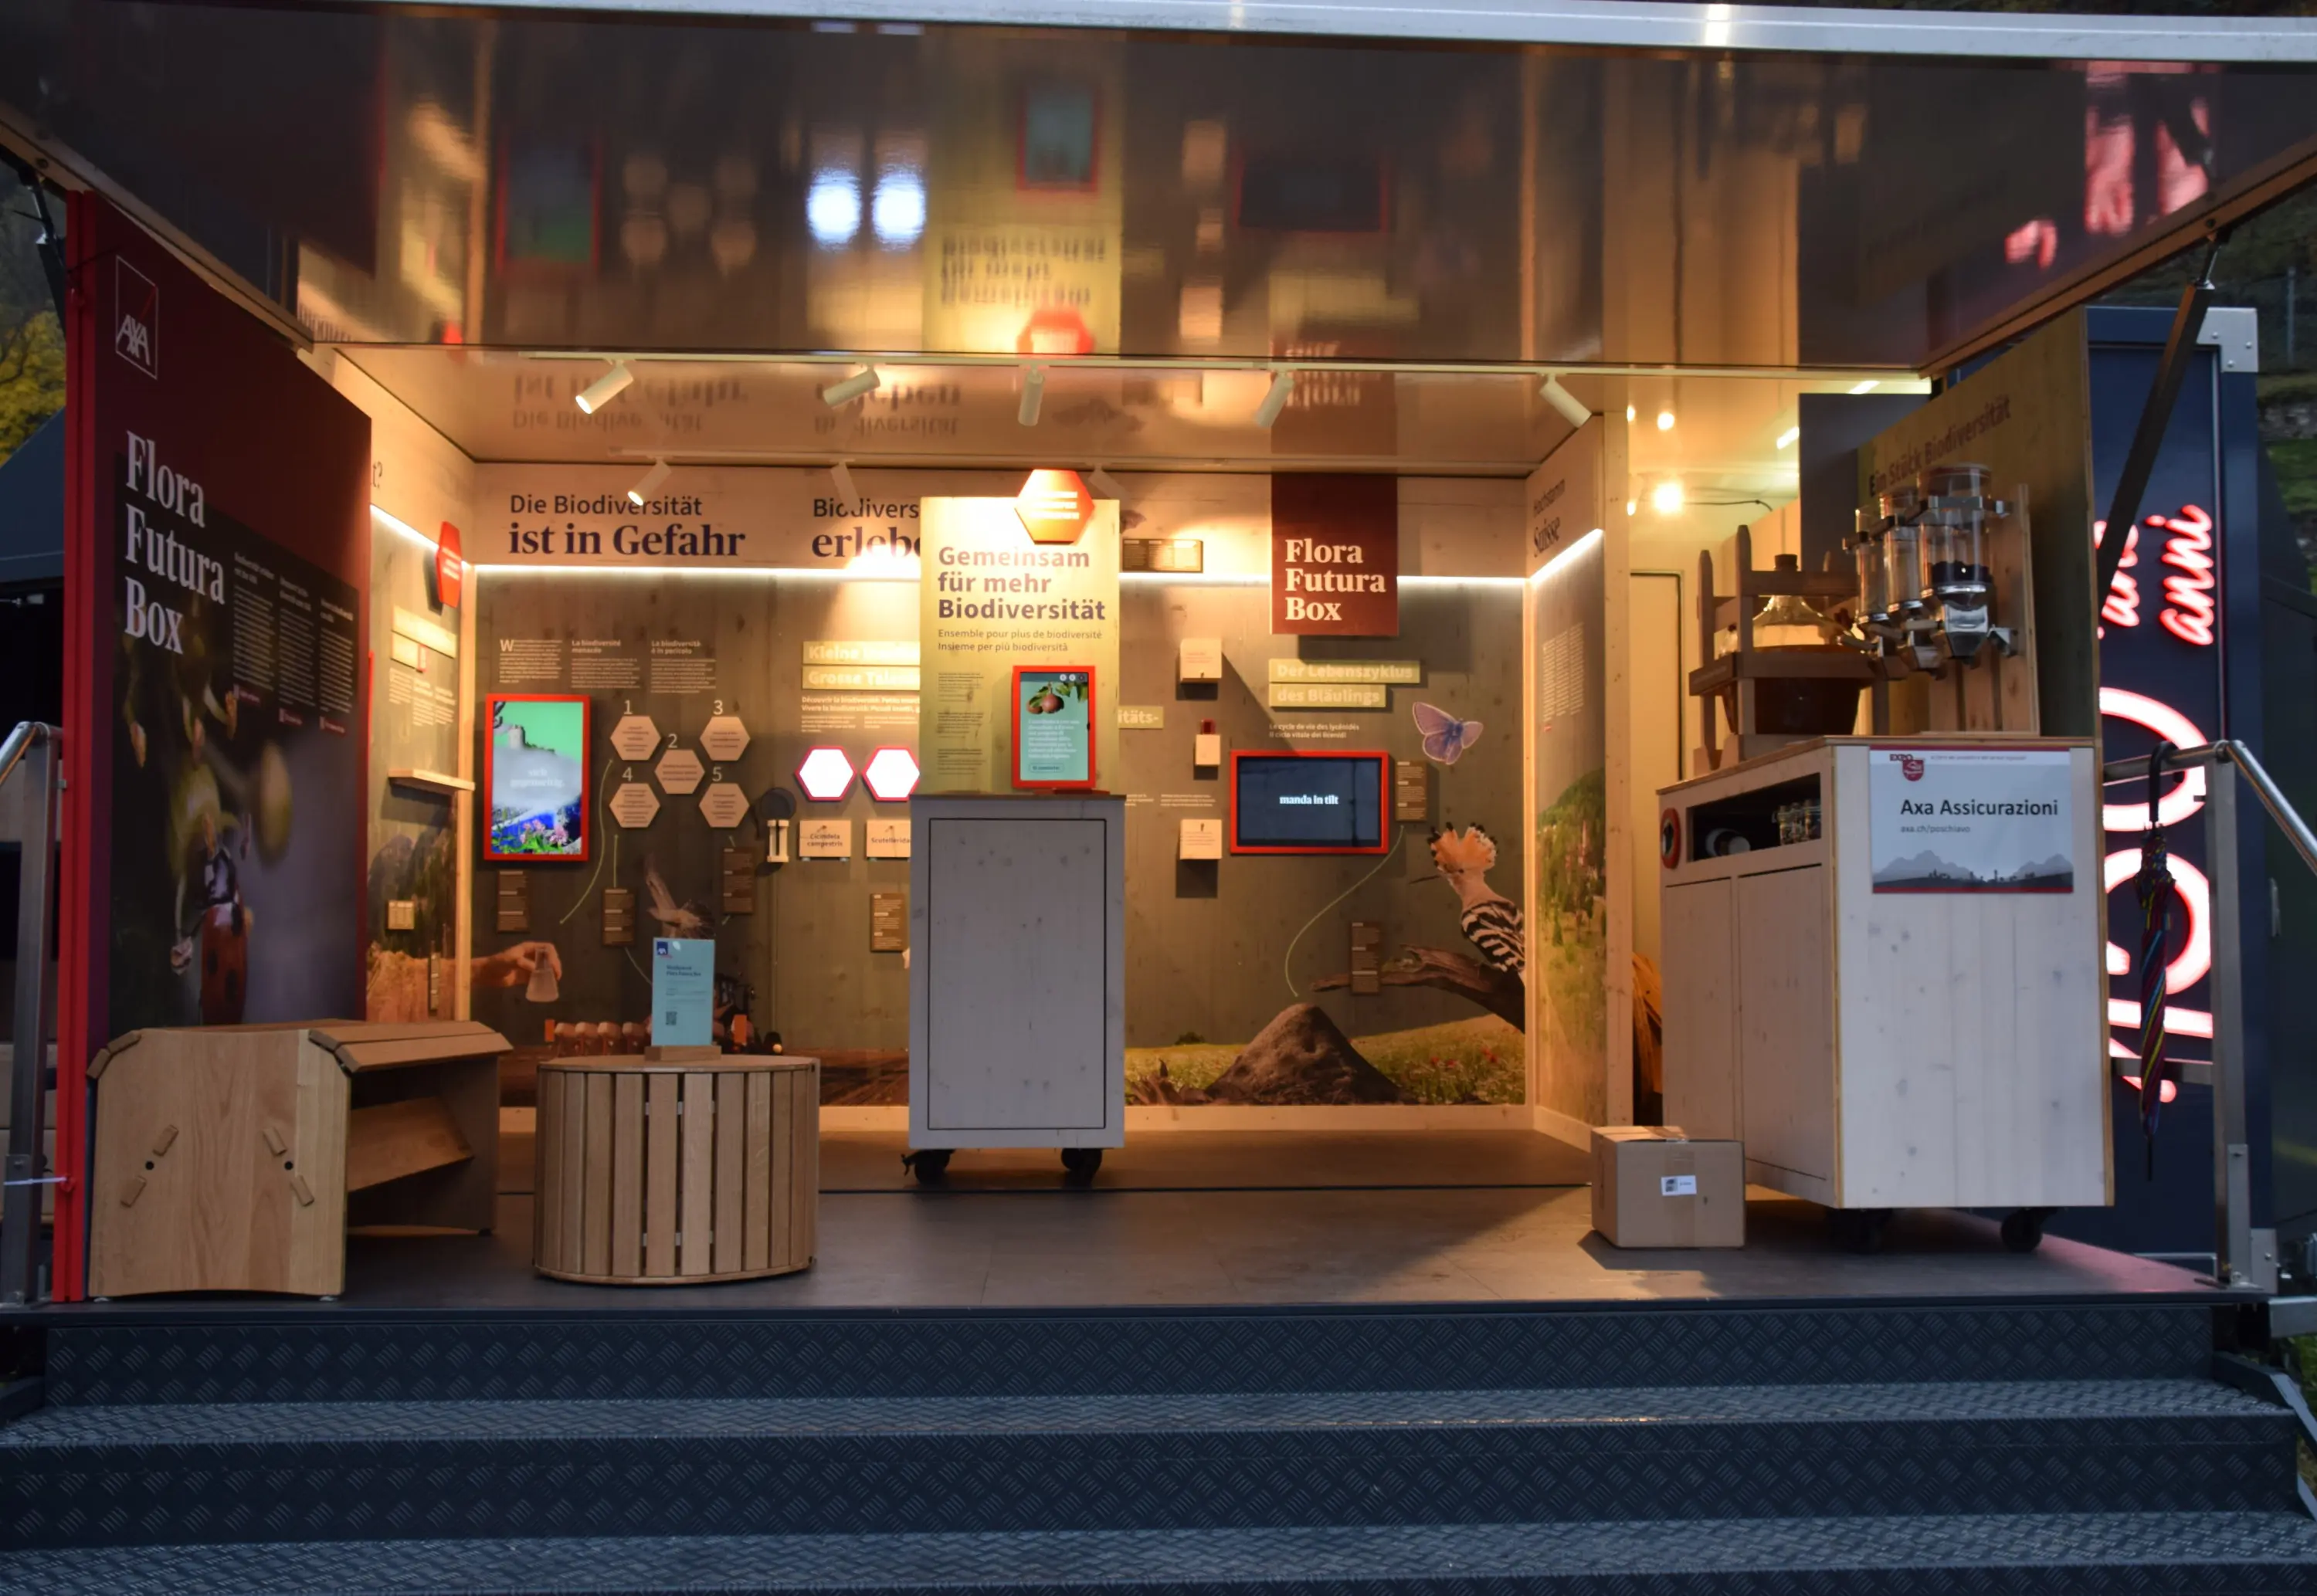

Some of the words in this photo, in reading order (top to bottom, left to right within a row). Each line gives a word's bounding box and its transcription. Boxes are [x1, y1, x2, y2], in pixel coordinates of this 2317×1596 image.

[116, 313, 151, 367] AXA
[1924, 394, 2012, 463] Biodiversität
[126, 429, 205, 529] Flora
[511, 494, 546, 514] Die
[555, 494, 703, 517] Biodiversität
[508, 523, 555, 554] ist
[565, 524, 602, 554] in
[612, 524, 747, 557] Gefahr
[1284, 537, 1364, 564] Flora
[124, 502, 226, 605] Futura
[938, 546, 1090, 568] Gemeinsam
[938, 571, 976, 592] für
[983, 573, 1052, 593] mehr
[1284, 568, 1387, 593] Futura
[2144, 504, 2214, 646] anni
[124, 576, 184, 655] Box
[938, 597, 1106, 621] Biodiversität
[1284, 597, 1342, 621] Box
[938, 629, 984, 639] Ensemble
[986, 631, 1009, 642] pour
[1011, 630, 1031, 642] plus
[1033, 630, 1045, 639] de
[1047, 630, 1103, 640] biodiversité
[938, 642, 975, 652] Insieme
[977, 645, 994, 655] per
[995, 642, 1010, 655] più
[1013, 642, 1069, 652] biodiversità
[1277, 664, 1304, 678] Der
[1308, 663, 1413, 679] Lebenszyklus
[623, 700, 633, 715] 1
[713, 700, 724, 715] 3
[1277, 689, 1304, 702] des
[1308, 689, 1380, 706] Bläulings
[667, 734, 678, 748] 2
[622, 767, 633, 781] 4
[712, 767, 722, 781] 5
[1279, 794, 1312, 805] manda
[1313, 794, 1323, 805] in
[1324, 794, 1339, 805] tilt
[1900, 798, 1934, 815] Axa
[1939, 798, 2059, 815] Assicurazioni
[1900, 825, 1971, 834] axa.ch/poschiavo
